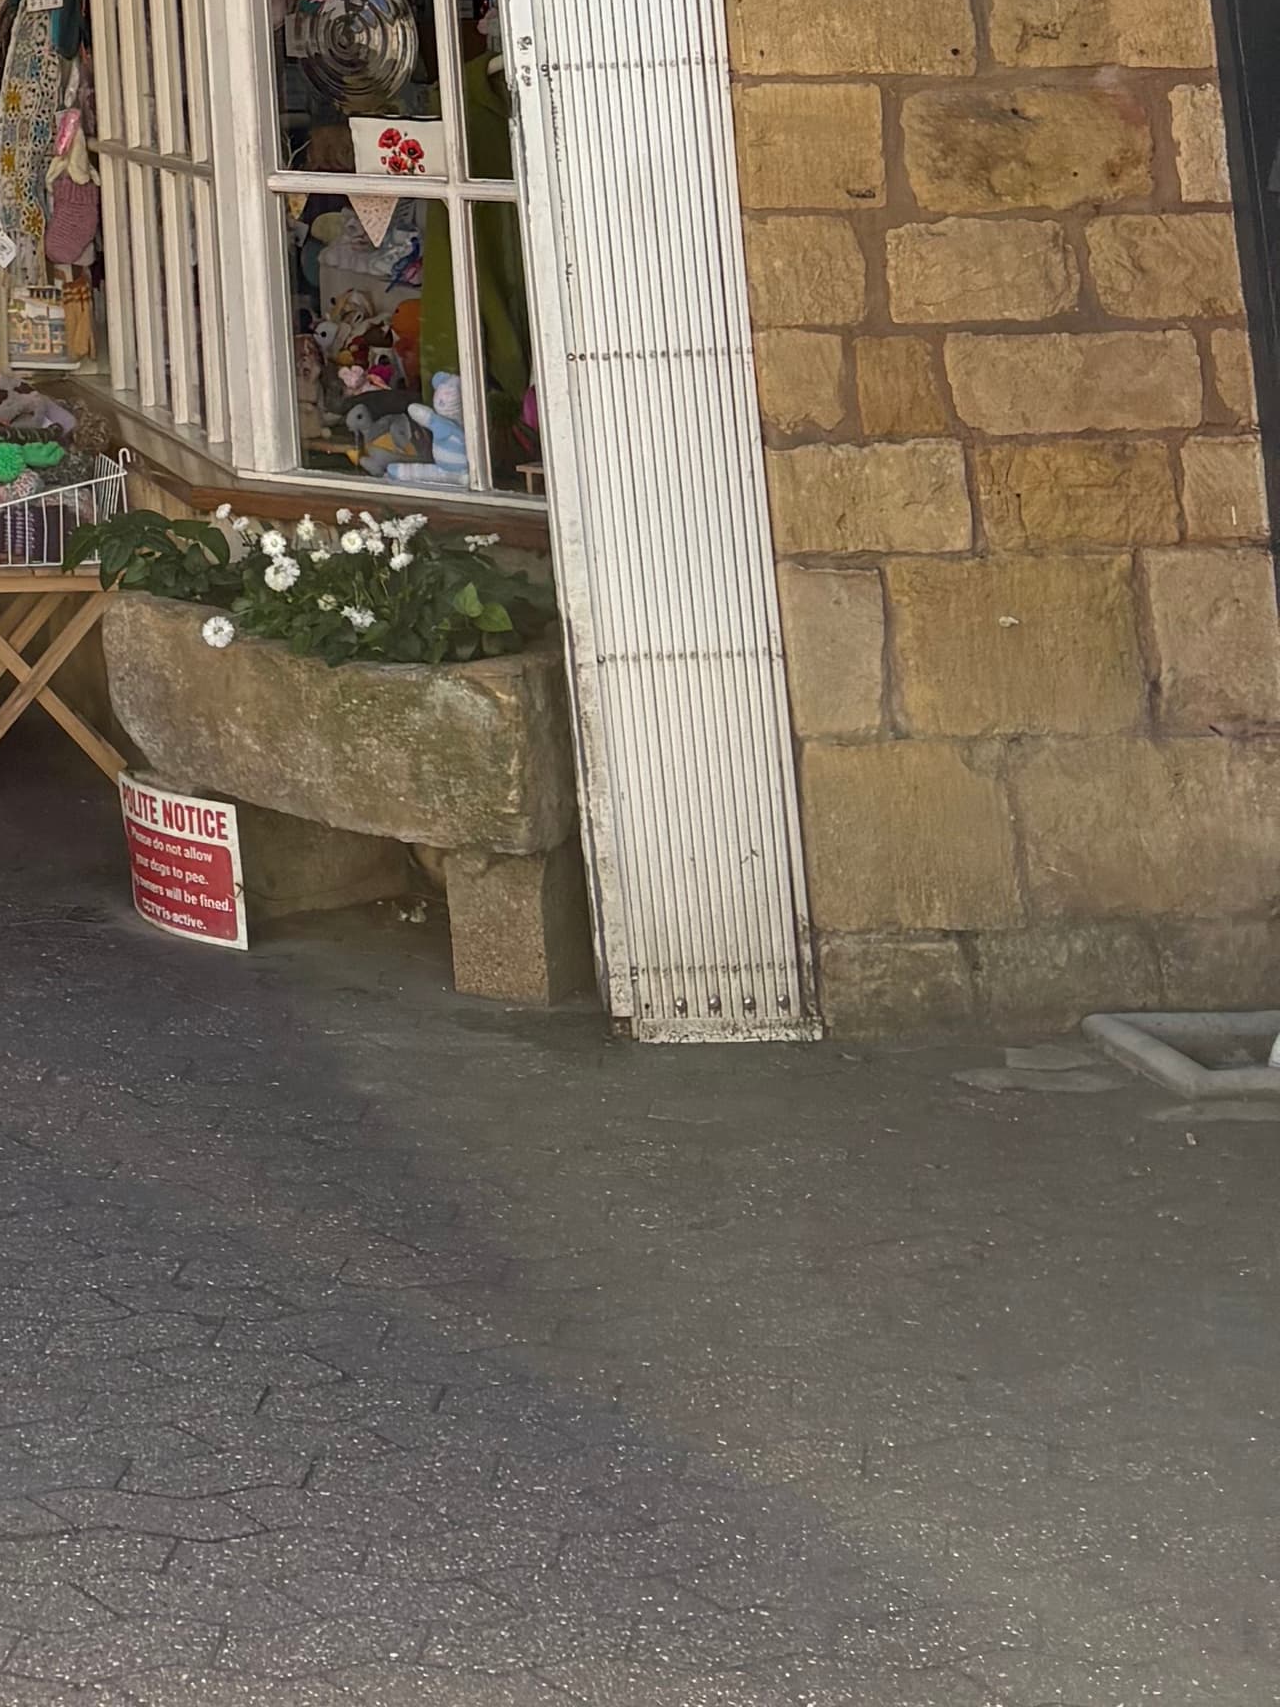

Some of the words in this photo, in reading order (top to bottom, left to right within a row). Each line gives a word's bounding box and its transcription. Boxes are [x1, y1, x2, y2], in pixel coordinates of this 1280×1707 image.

[122, 781, 158, 825] POLITE
[161, 799, 229, 841] NOTICE
[153, 838, 165, 851] do
[165, 843, 182, 856] not
[183, 847, 213, 862] allow
[150, 858, 171, 876] dogs
[172, 867, 183, 879] to
[184, 871, 209, 885] pee.
[165, 886, 182, 902] will
[183, 890, 198, 905] be
[199, 894, 233, 912] fined.
[162, 907, 171, 920] is
[172, 912, 207, 930] active.
